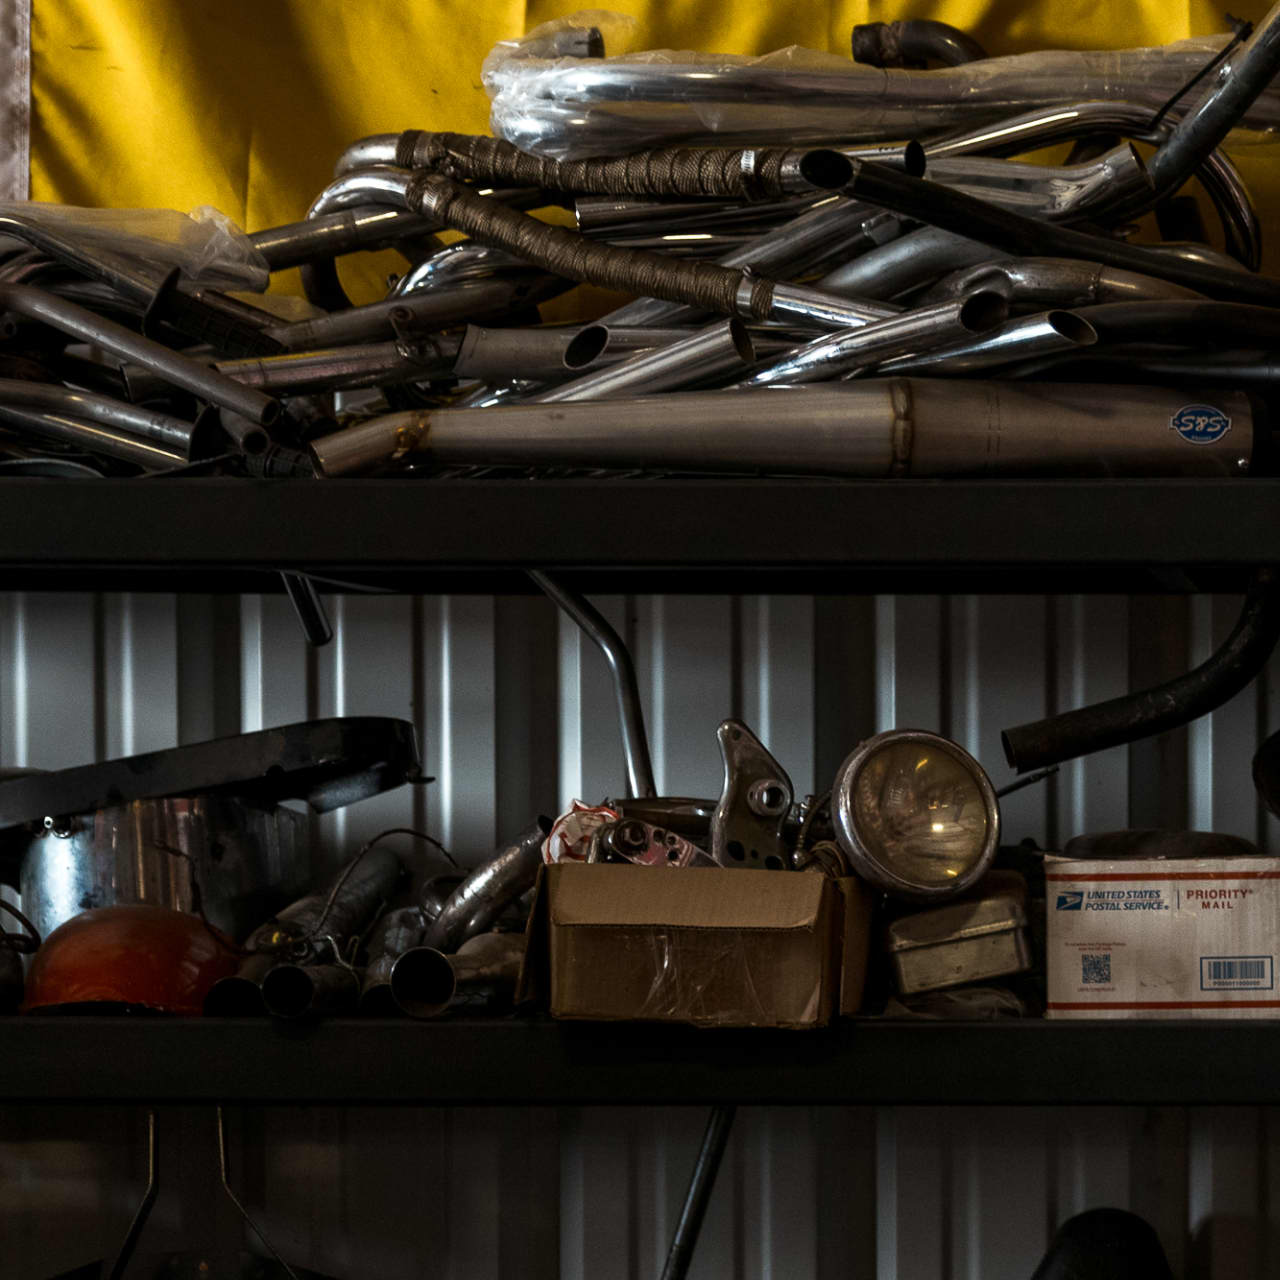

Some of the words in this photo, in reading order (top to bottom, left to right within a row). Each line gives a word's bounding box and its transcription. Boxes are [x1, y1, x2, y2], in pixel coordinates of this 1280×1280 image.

[1087, 890, 1125, 899] UNITED
[1126, 889, 1161, 899] STATES
[1085, 901, 1122, 911] POSTAL
[1201, 901, 1233, 910] MAIL
